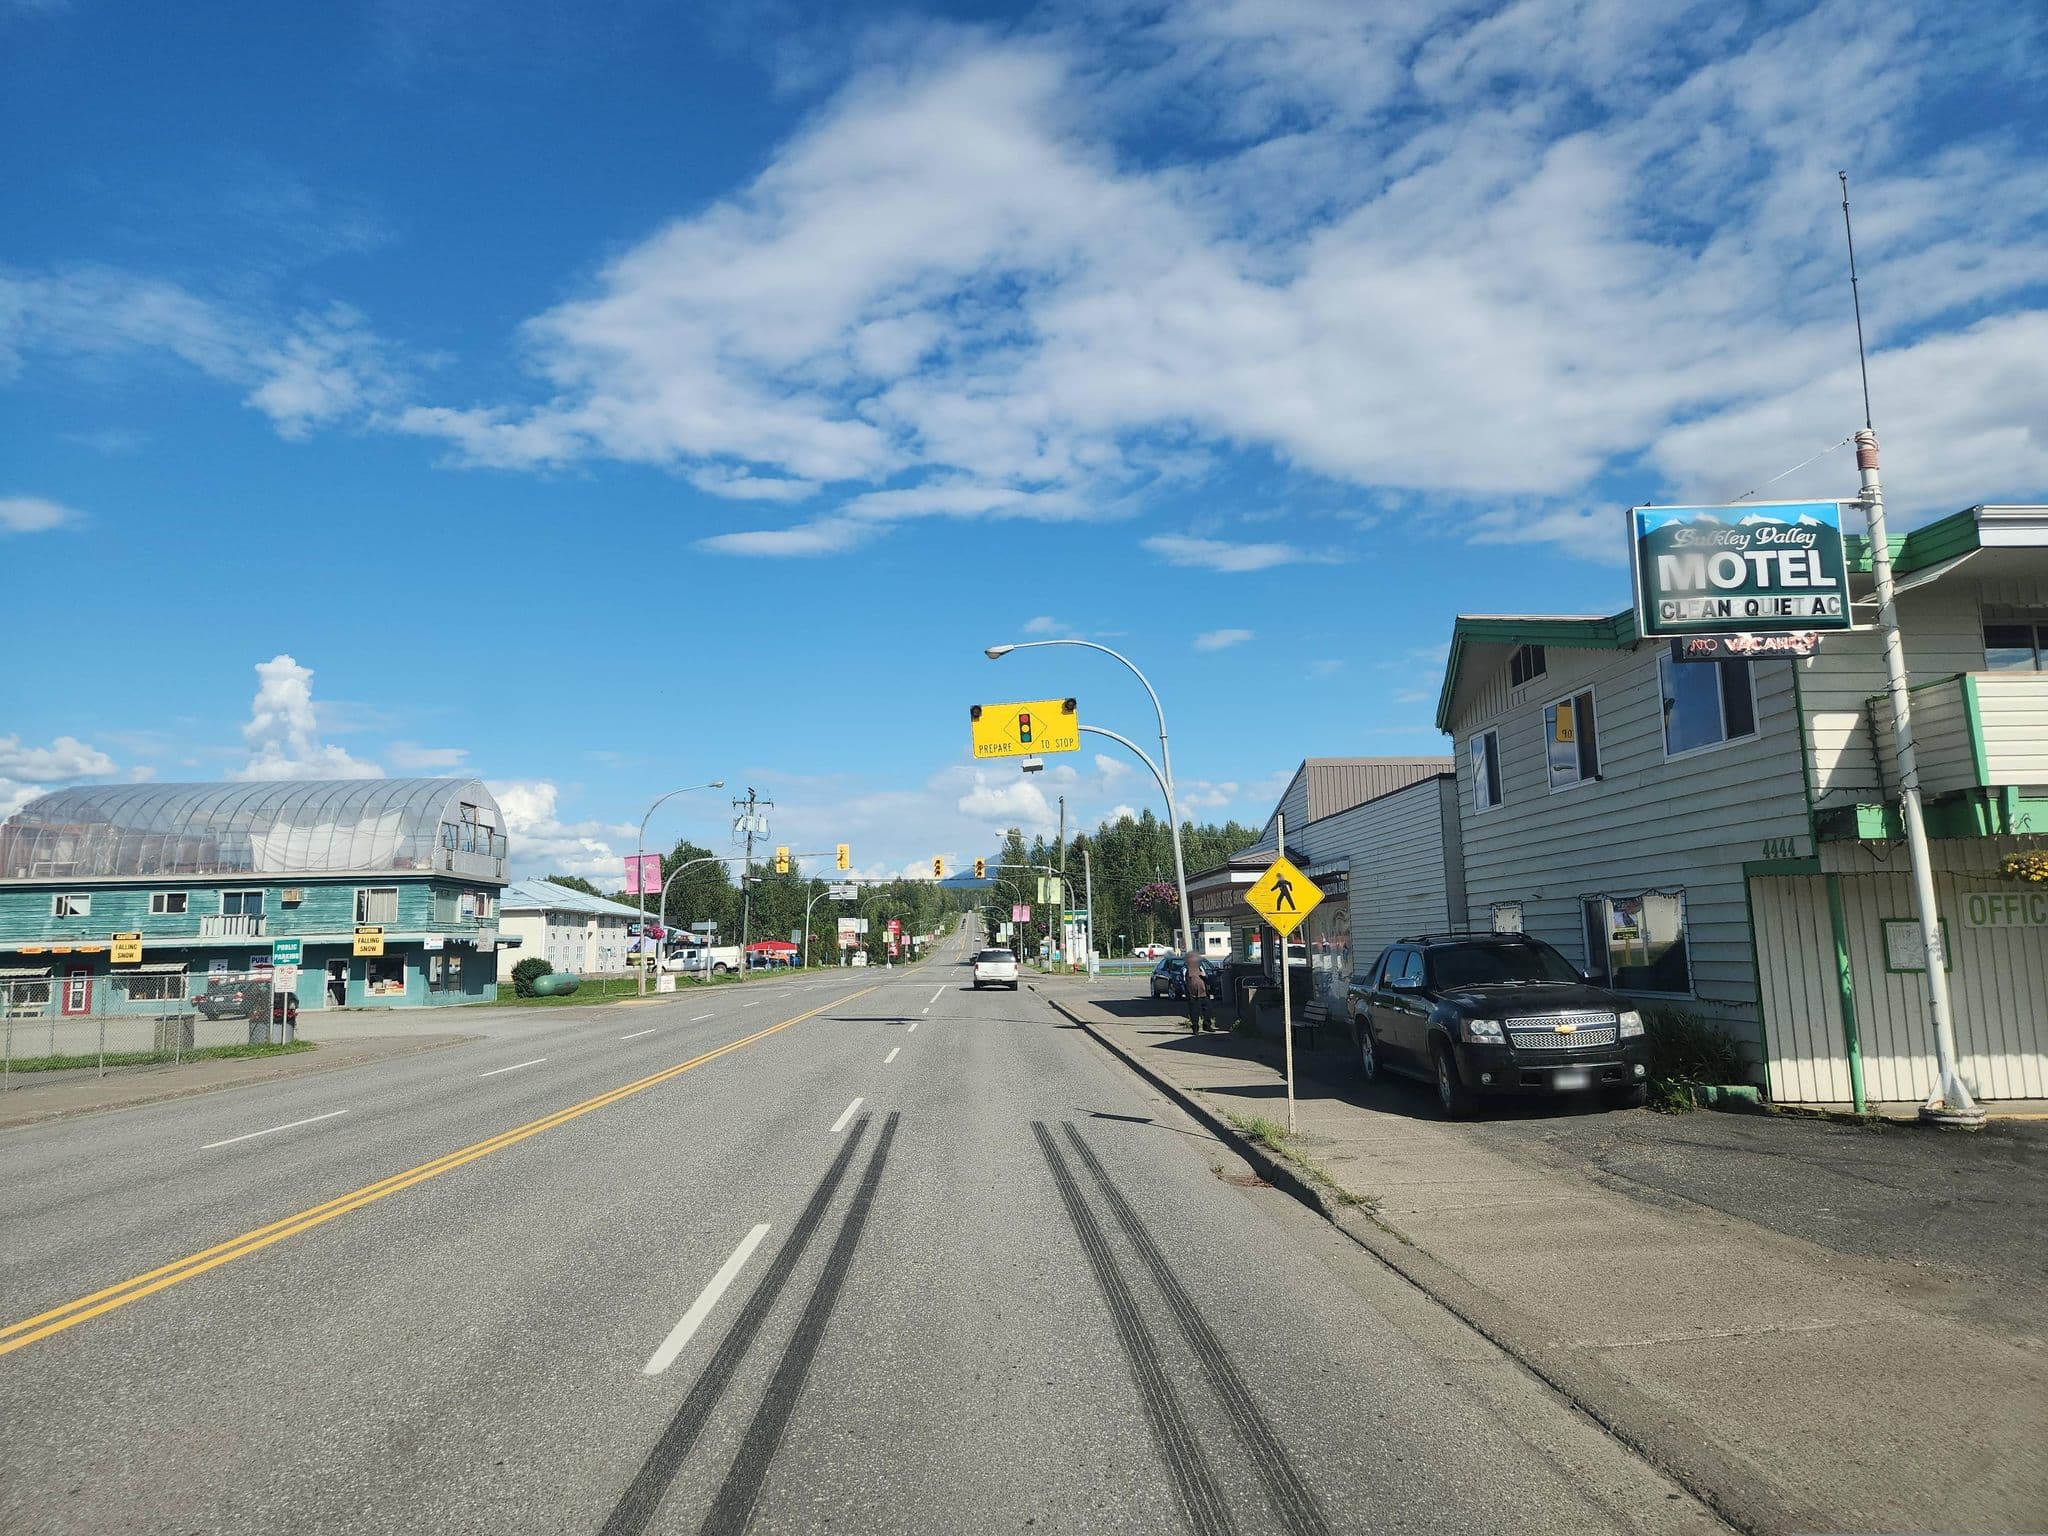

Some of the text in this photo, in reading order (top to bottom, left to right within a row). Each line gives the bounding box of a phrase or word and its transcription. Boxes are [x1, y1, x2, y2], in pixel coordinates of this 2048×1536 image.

[1755, 526, 1817, 549] Valley
[1657, 549, 1837, 592] MOTEL
[1660, 596, 1841, 619] CLEAN QUIET AC
[1690, 638, 1718, 652] NO
[978, 737, 1074, 754] PREPARE TO STOP
[1762, 837, 1796, 858] 4444
[1969, 894, 2048, 925] OFFIC
